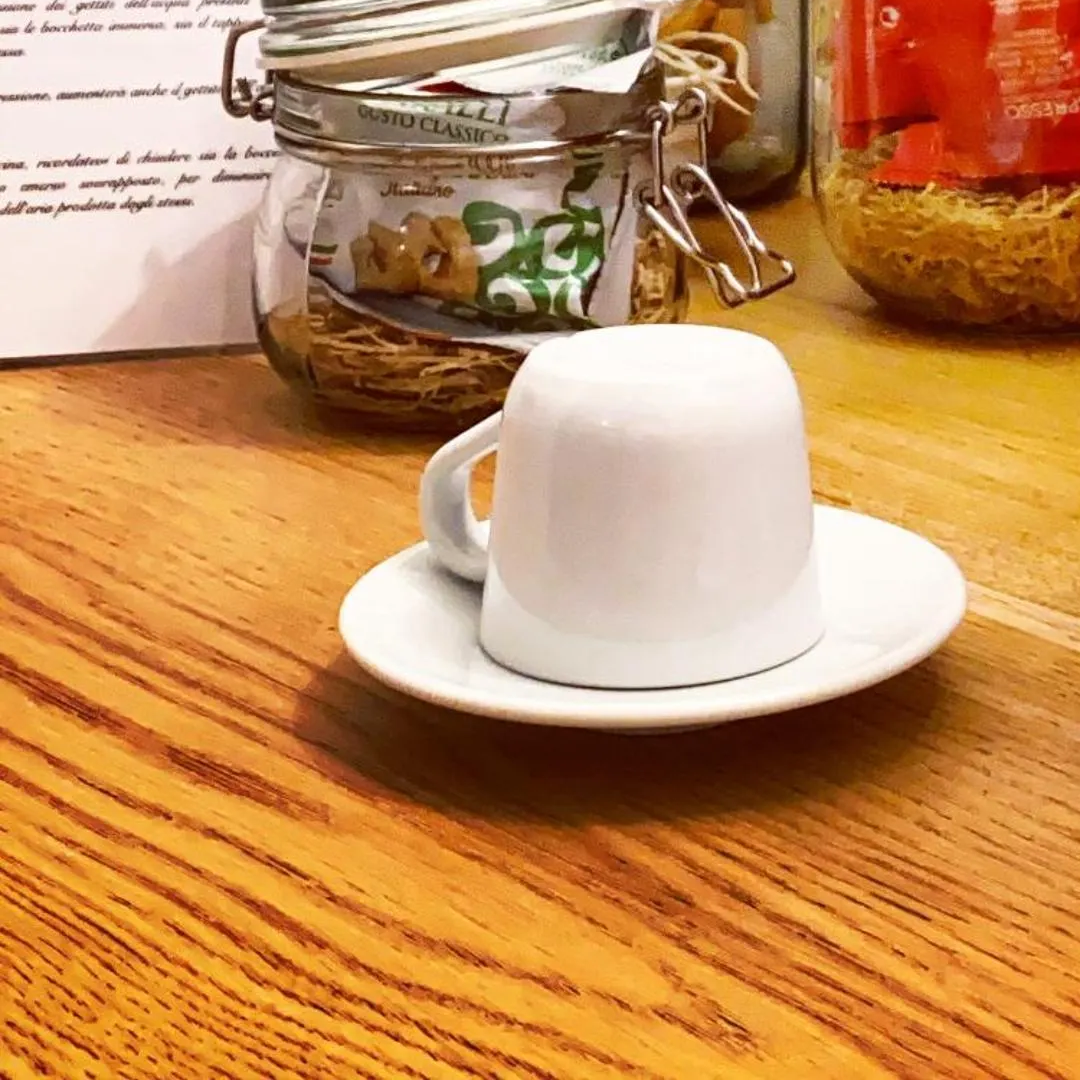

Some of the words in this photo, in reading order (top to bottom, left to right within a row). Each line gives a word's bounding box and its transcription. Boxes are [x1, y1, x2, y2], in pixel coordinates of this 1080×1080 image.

[357, 104, 416, 129] GUSTO
[420, 117, 509, 143] CLASSICO
[174, 173, 201, 190] per
